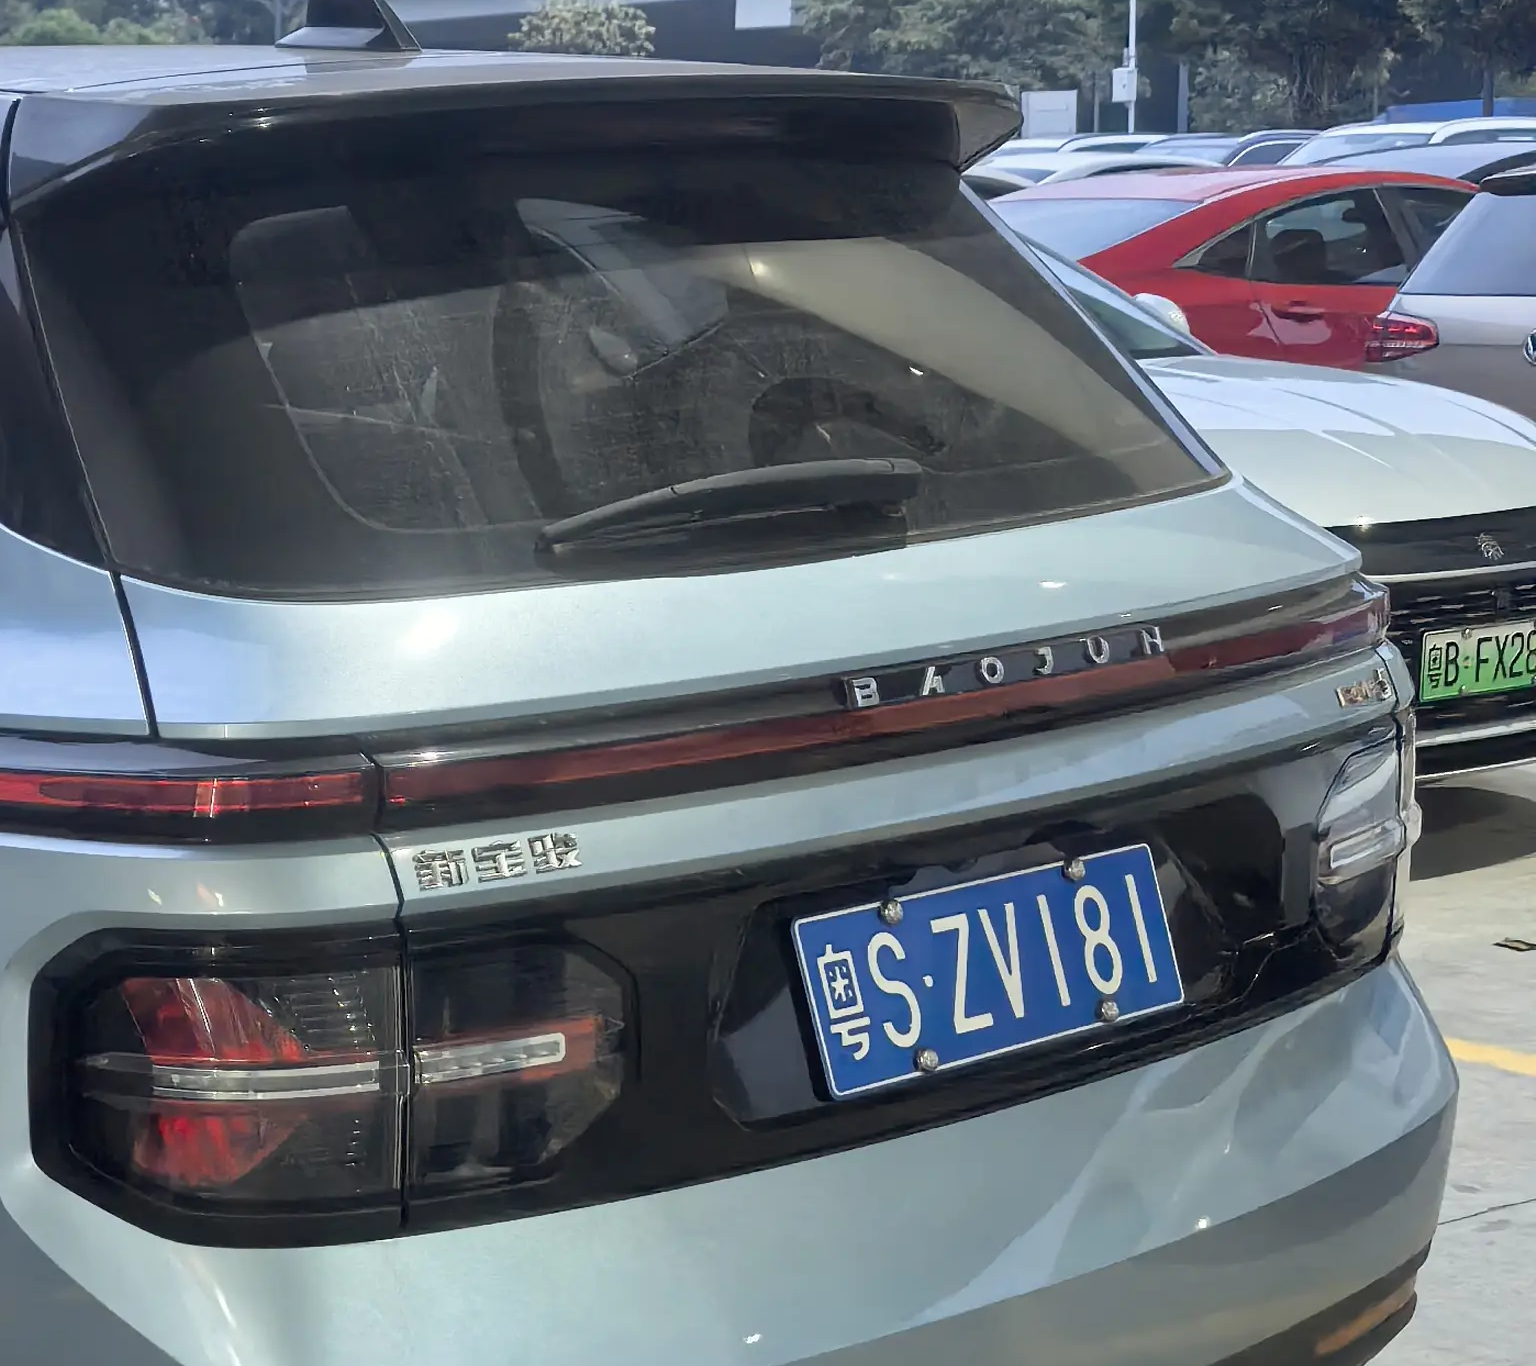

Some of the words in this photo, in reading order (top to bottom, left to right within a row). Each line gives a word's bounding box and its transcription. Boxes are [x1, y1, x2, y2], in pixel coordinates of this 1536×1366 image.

[846, 624, 1165, 709] BAOJUN
[413, 832, 583, 892] 新宝骏
[816, 873, 1158, 1061] 粤S·ZV181
